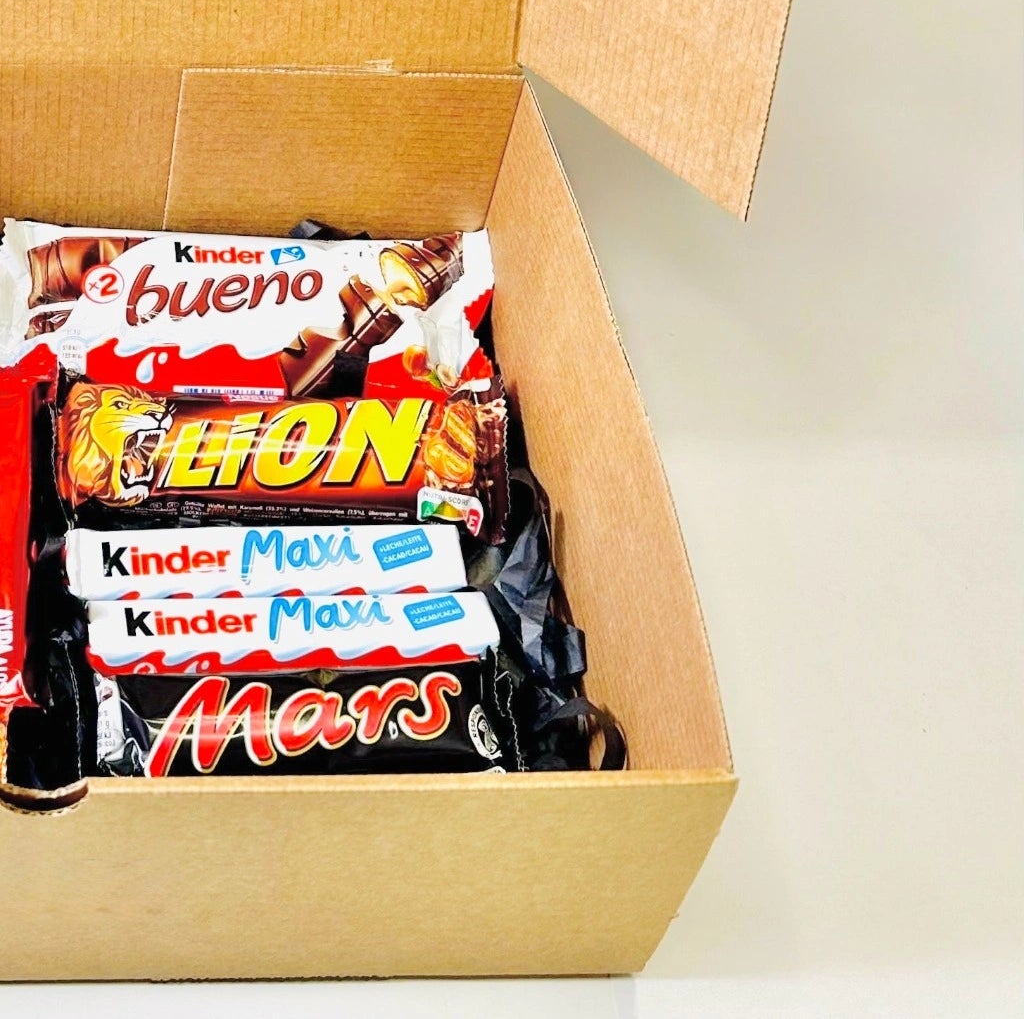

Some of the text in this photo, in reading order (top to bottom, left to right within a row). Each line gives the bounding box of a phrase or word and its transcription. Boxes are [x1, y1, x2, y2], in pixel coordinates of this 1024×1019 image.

[126, 264, 323, 326] bueno
[241, 527, 361, 584] Maxi
[268, 594, 391, 642] Maxi
[145, 671, 462, 778] Mars
